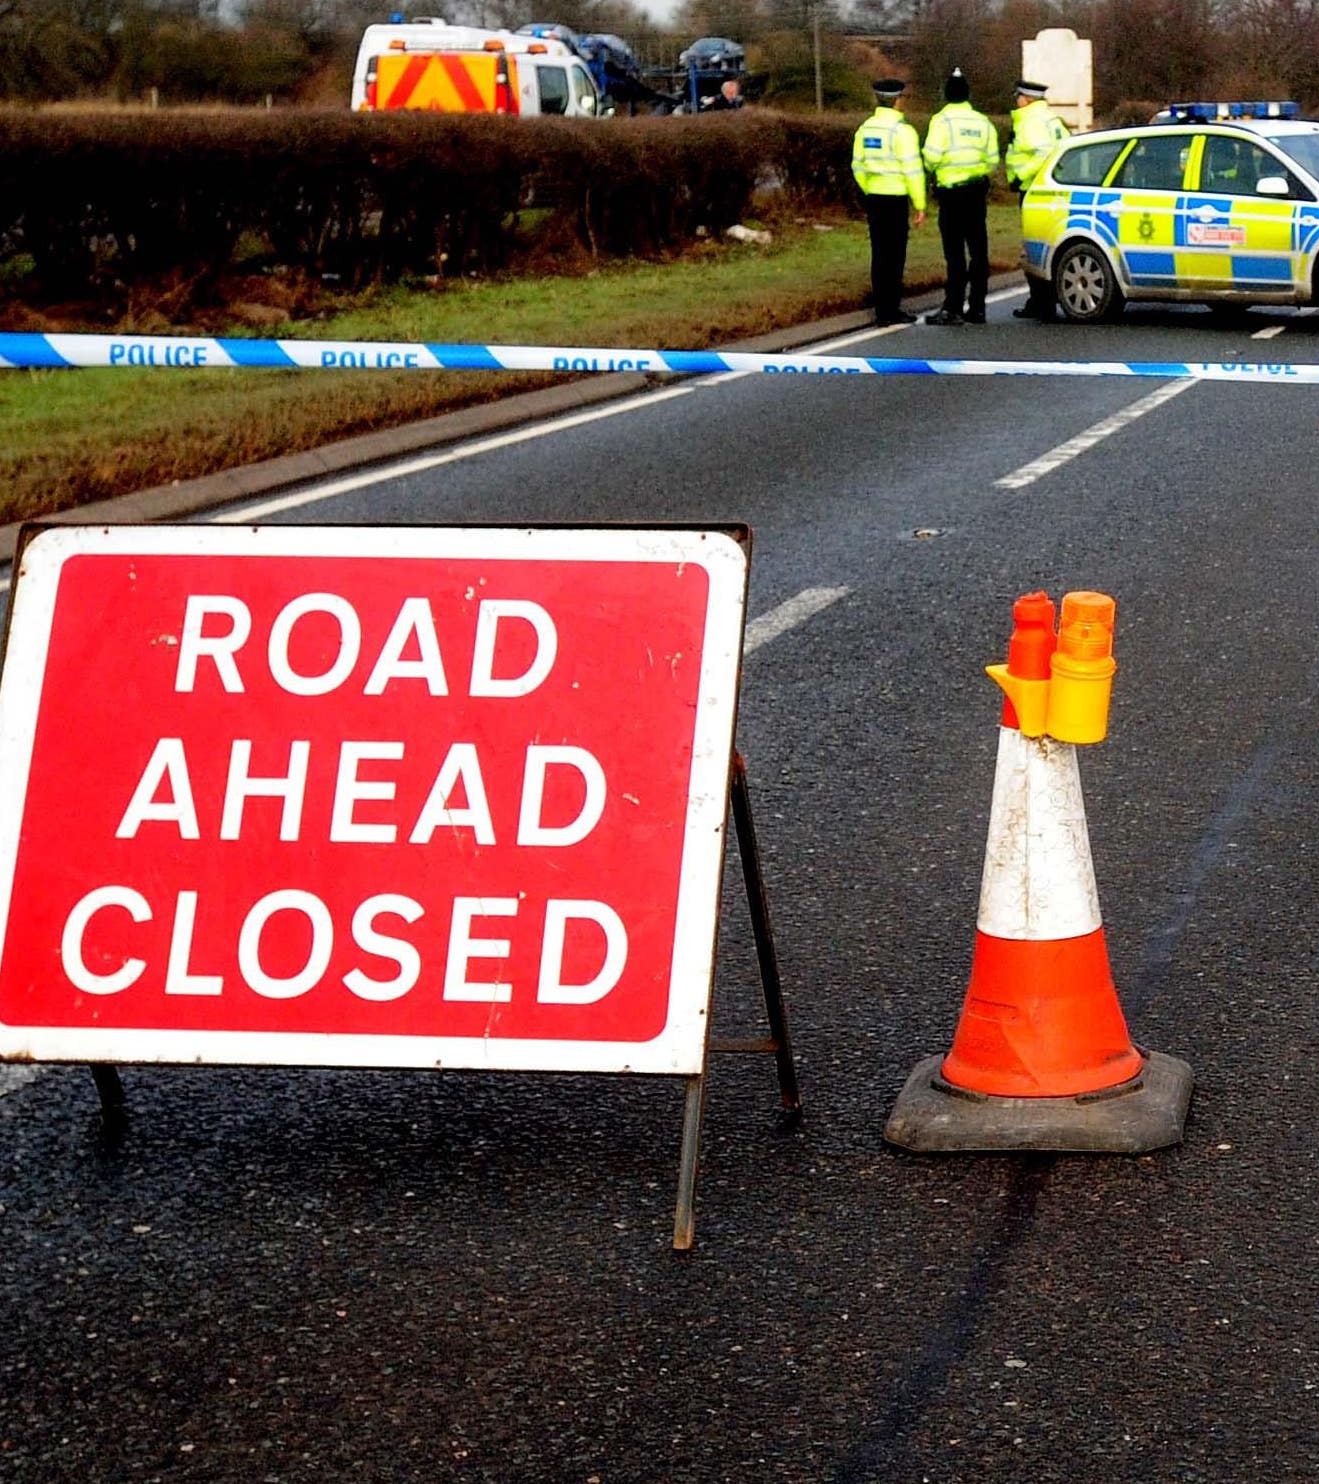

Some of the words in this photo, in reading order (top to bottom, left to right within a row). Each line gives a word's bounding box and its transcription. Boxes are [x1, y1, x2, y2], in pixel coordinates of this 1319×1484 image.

[109, 343, 207, 366] POLICE
[321, 351, 418, 368] POLICE
[174, 593, 558, 698] ROAD
[115, 738, 607, 847] AHEAD
[61, 885, 629, 1005] CLOSED
